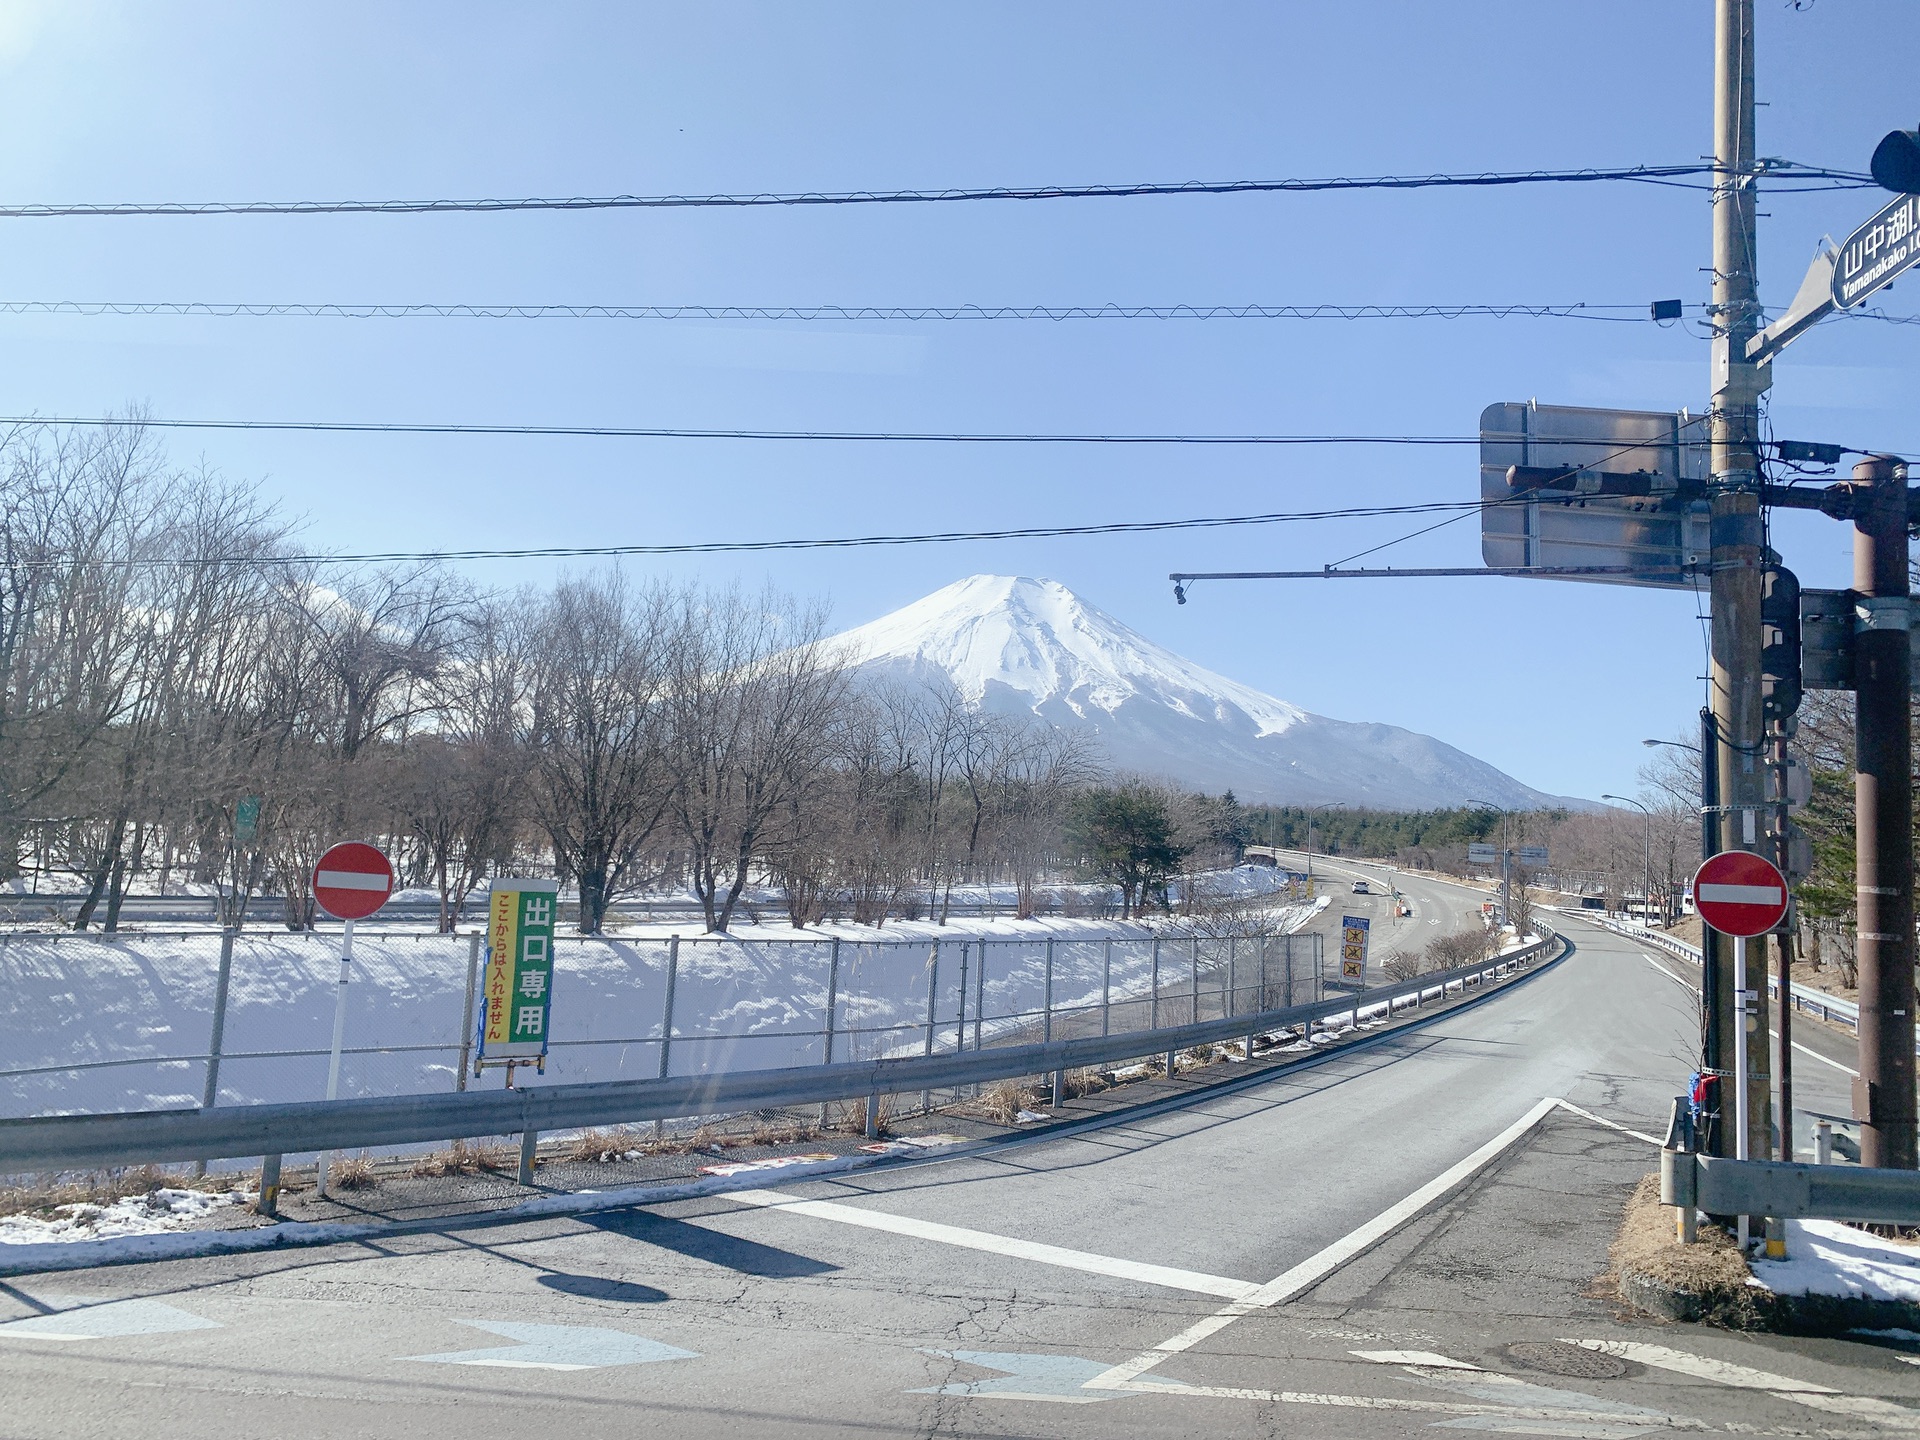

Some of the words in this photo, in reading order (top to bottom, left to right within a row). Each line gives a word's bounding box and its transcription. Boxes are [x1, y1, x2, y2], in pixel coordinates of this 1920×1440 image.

[1843, 245, 1907, 301] Yamanakako
[488, 894, 509, 1040] ここからは入れません
[515, 897, 551, 1036] 出口専用
